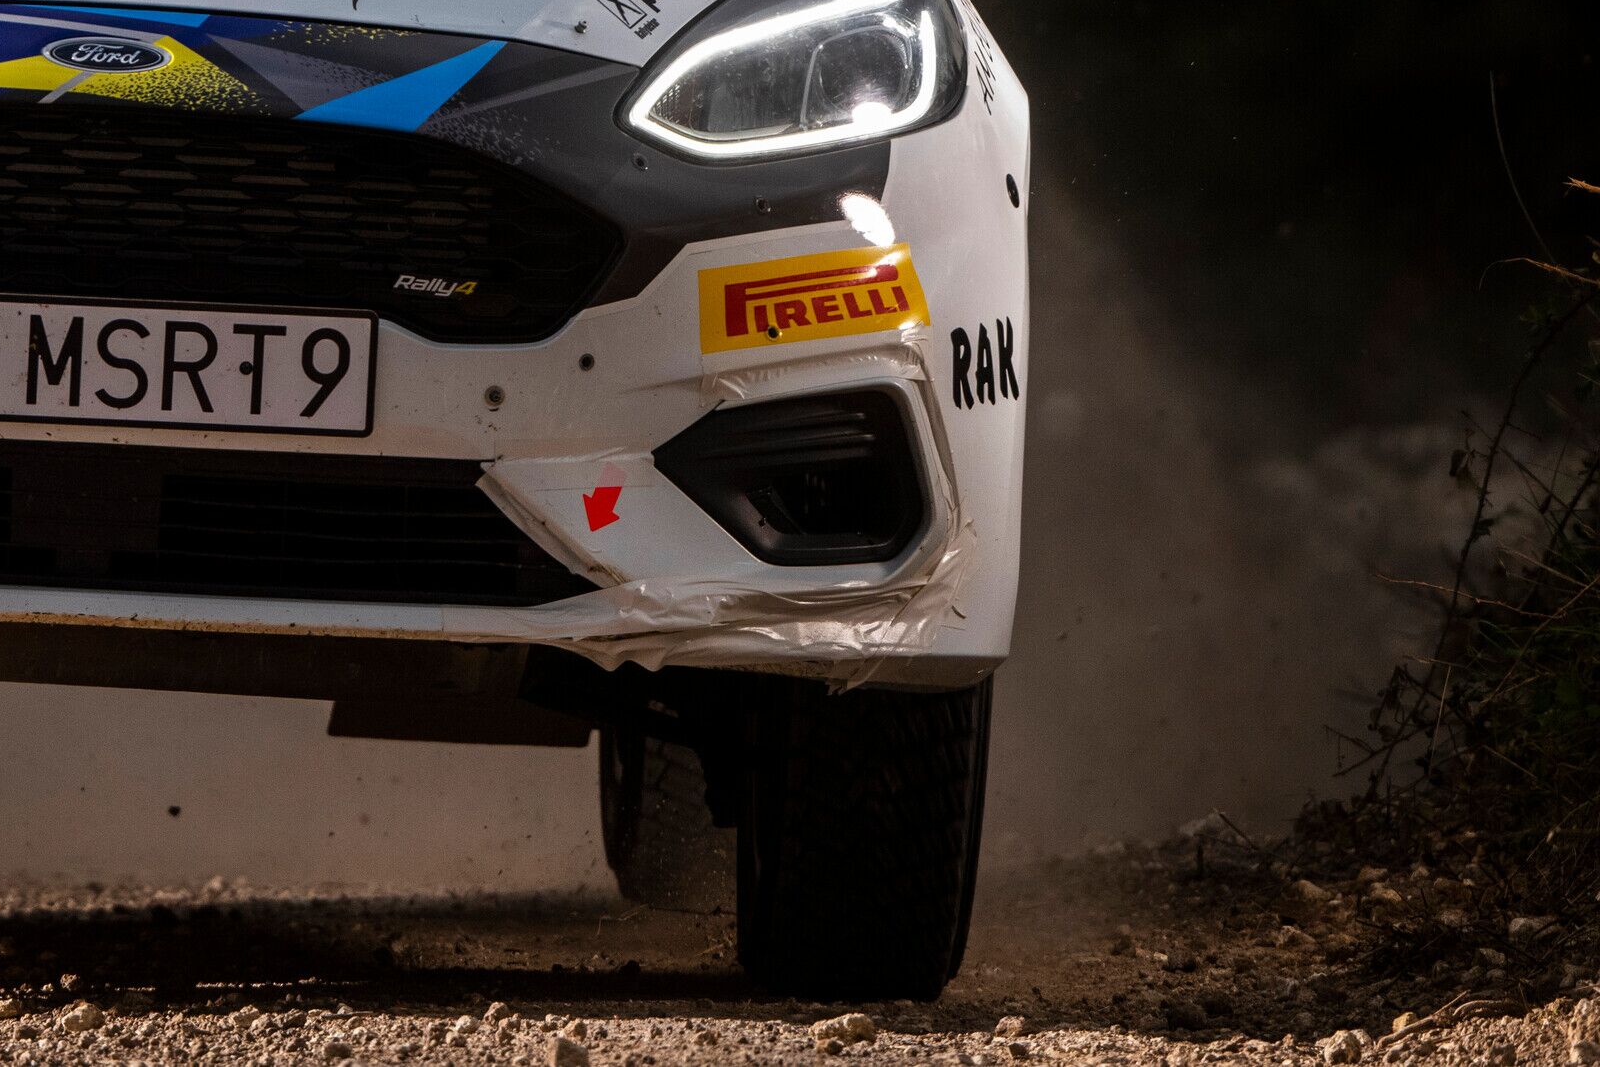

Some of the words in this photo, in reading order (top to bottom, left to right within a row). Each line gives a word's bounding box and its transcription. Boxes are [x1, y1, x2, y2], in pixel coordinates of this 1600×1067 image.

[71, 40, 141, 66] Ford
[393, 275, 477, 296] Rally4
[724, 264, 910, 337] PIRELLI
[26, 316, 351, 418] MSRT9
[950, 316, 1020, 411] RAK
